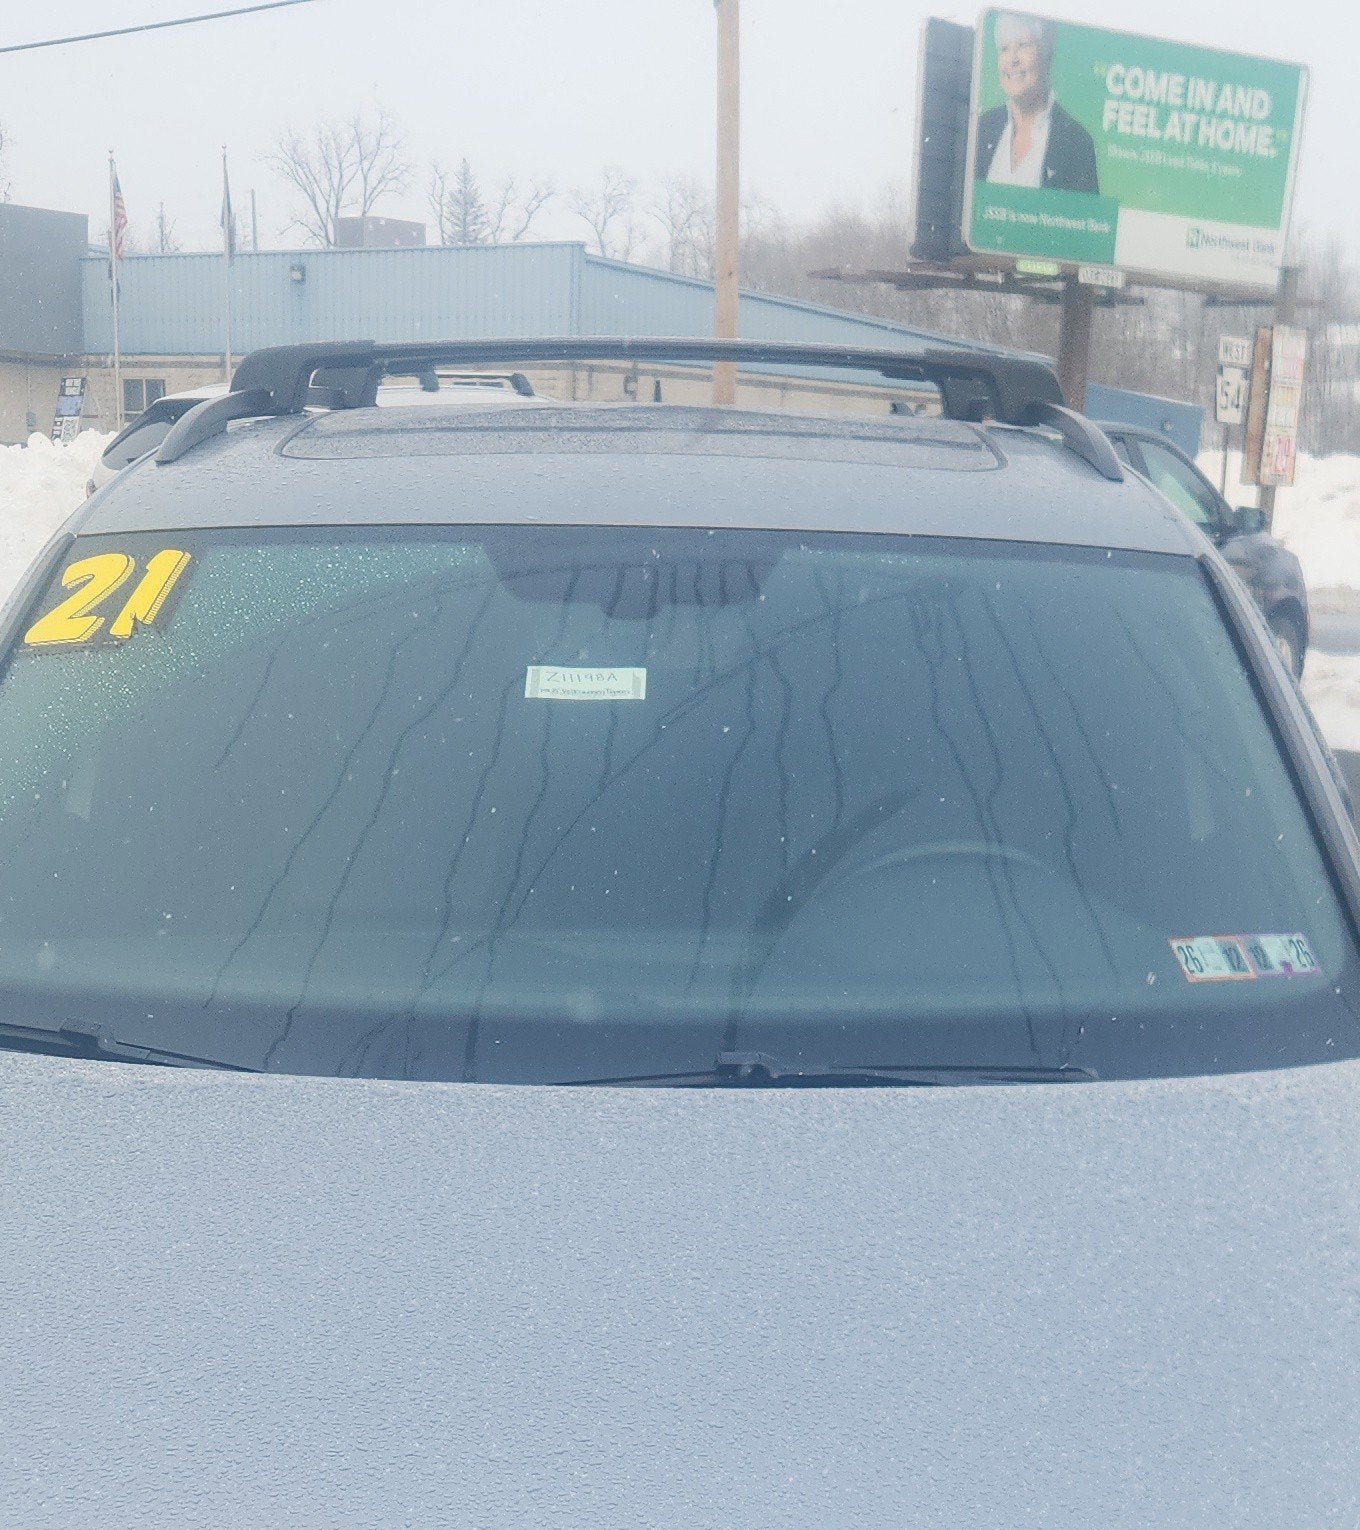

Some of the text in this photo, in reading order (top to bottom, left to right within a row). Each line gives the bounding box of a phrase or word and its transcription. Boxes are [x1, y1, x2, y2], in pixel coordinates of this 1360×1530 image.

[1187, 76, 1217, 111] IN
[1216, 84, 1272, 121] AND
[1103, 99, 1161, 139] FEEL
[1163, 111, 1199, 144] AT
[24, 549, 192, 647] 21
[1176, 945, 1205, 974] 26
[1287, 938, 1316, 967] 26
